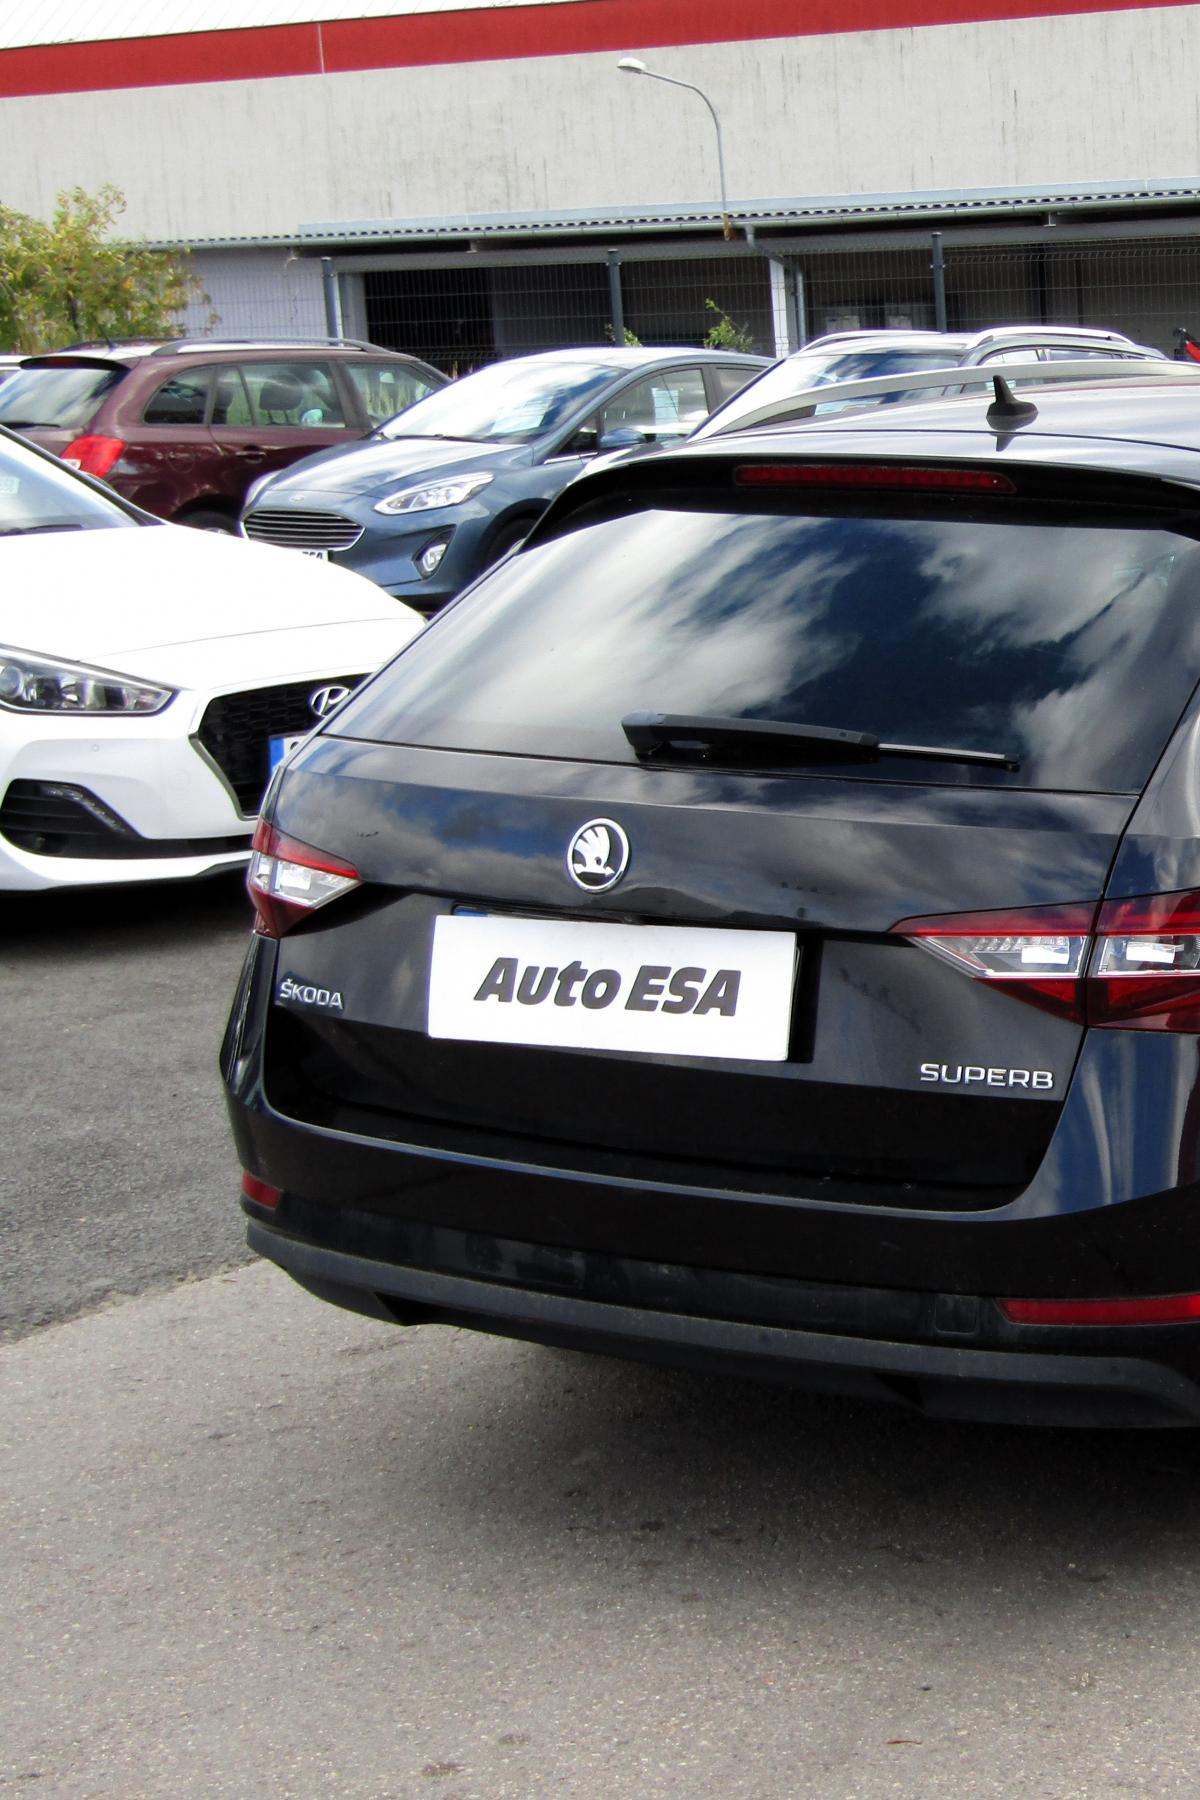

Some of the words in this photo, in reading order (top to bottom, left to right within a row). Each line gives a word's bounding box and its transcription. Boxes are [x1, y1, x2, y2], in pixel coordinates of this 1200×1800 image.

[279, 978, 343, 1010] ŠKODA
[473, 957, 622, 1010] Auto
[624, 964, 741, 1017] ESA
[920, 1063, 1053, 1089] SUPERB
